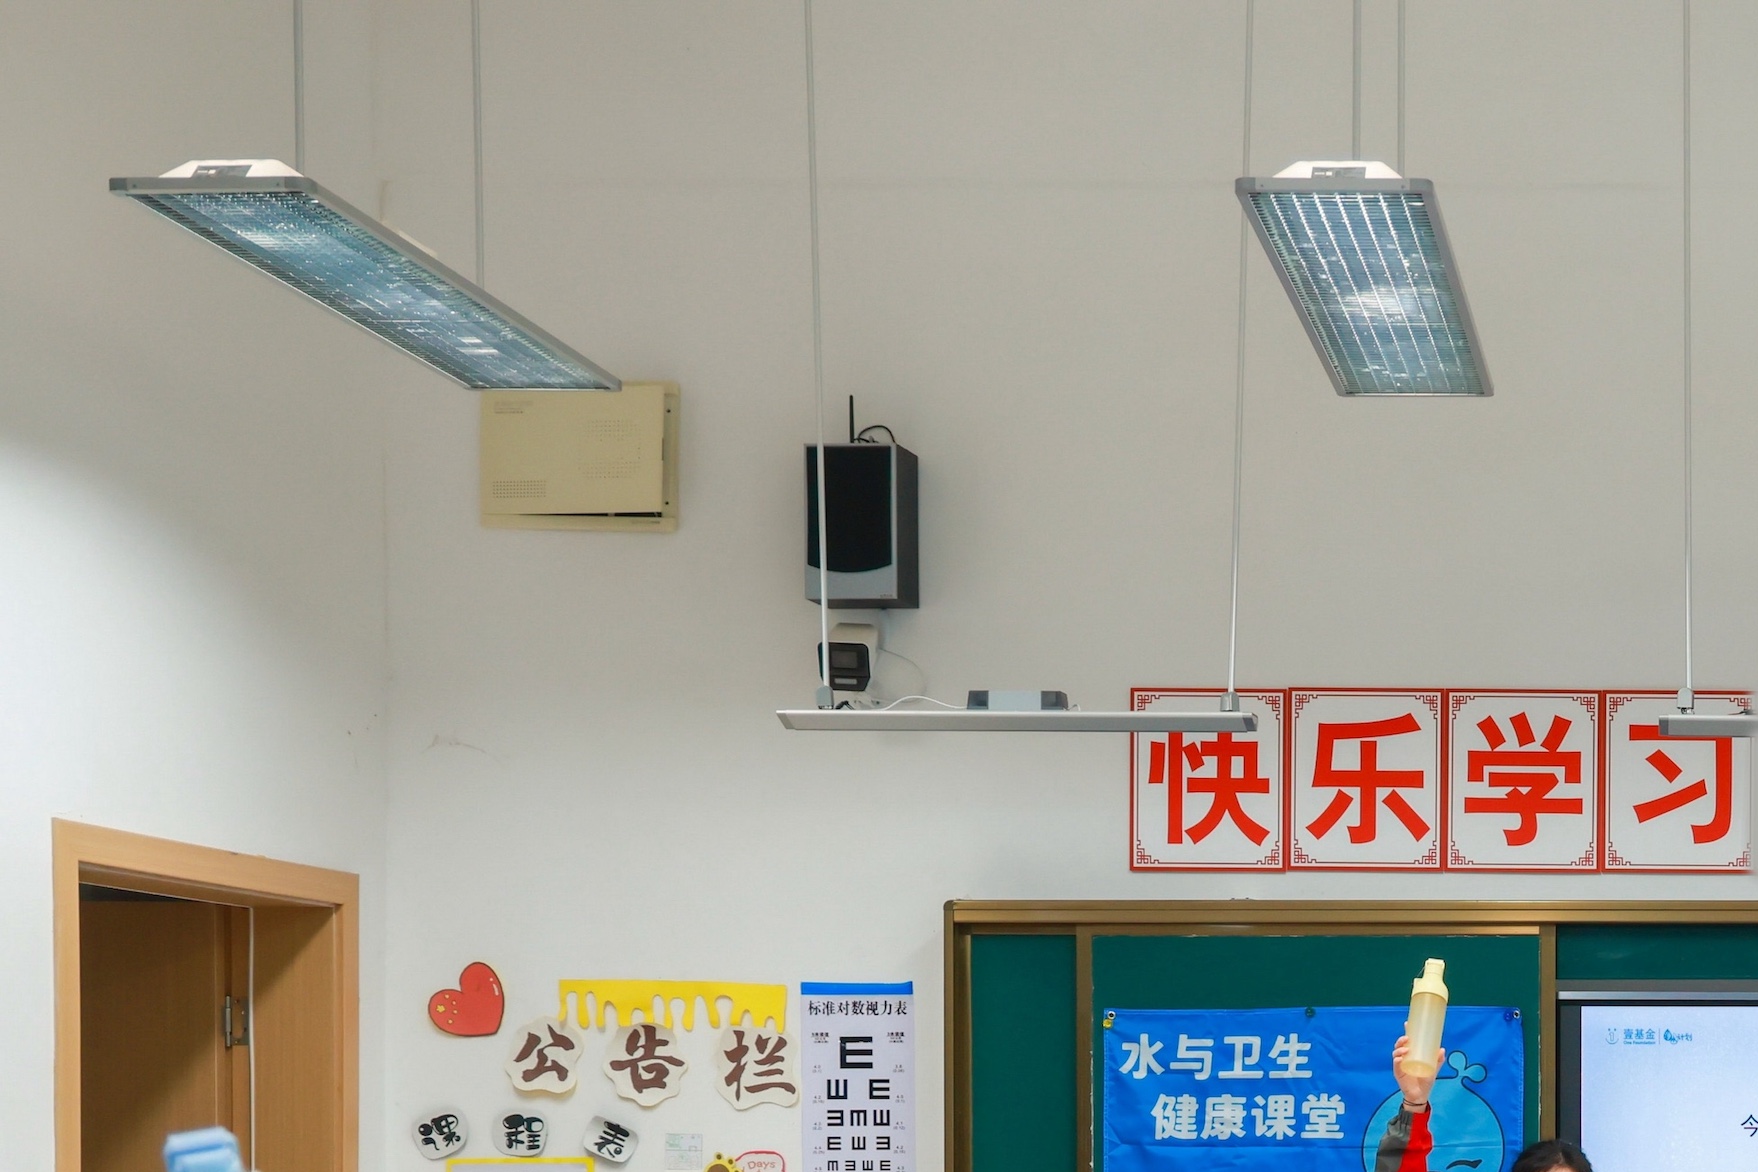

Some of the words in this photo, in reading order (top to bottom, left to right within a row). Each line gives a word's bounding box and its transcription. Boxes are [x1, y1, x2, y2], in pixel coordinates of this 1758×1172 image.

[1148, 711, 1733, 847] 快乐学习
[808, 1000, 908, 1016] 标准对数视力表
[513, 1023, 796, 1101] 公告栏
[1119, 1033, 1313, 1081] 水与卫生
[418, 1113, 631, 1158] 课程表
[1150, 1093, 1346, 1141] 健康课堂
[747, 1160, 777, 1170] Days
